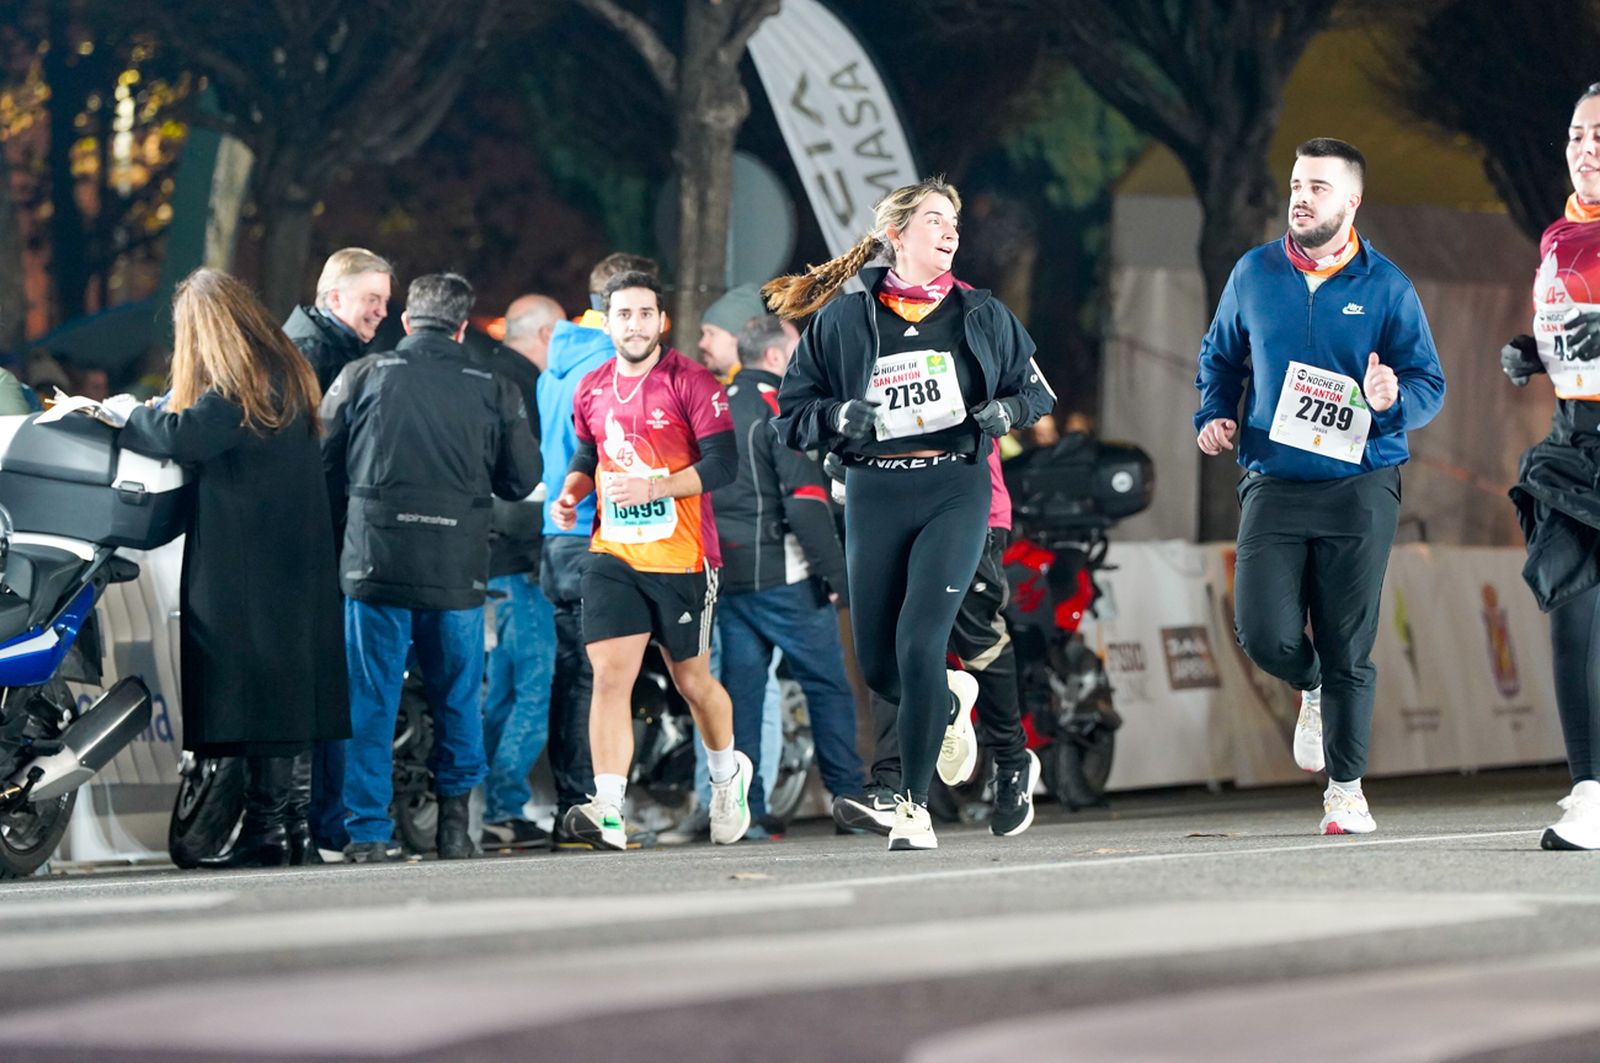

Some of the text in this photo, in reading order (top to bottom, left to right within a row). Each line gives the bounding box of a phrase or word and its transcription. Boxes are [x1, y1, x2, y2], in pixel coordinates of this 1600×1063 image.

[881, 363, 907, 375] NOCHE
[908, 361, 918, 369] DE
[873, 377, 891, 388] SAN
[1294, 382, 1343, 403] SAN ANTÓN
[1306, 376, 1334, 391] NOCHE
[1334, 383, 1345, 393] DE
[885, 378, 941, 411] 2738
[1295, 395, 1354, 432] 2739
[616, 447, 634, 467] 43
